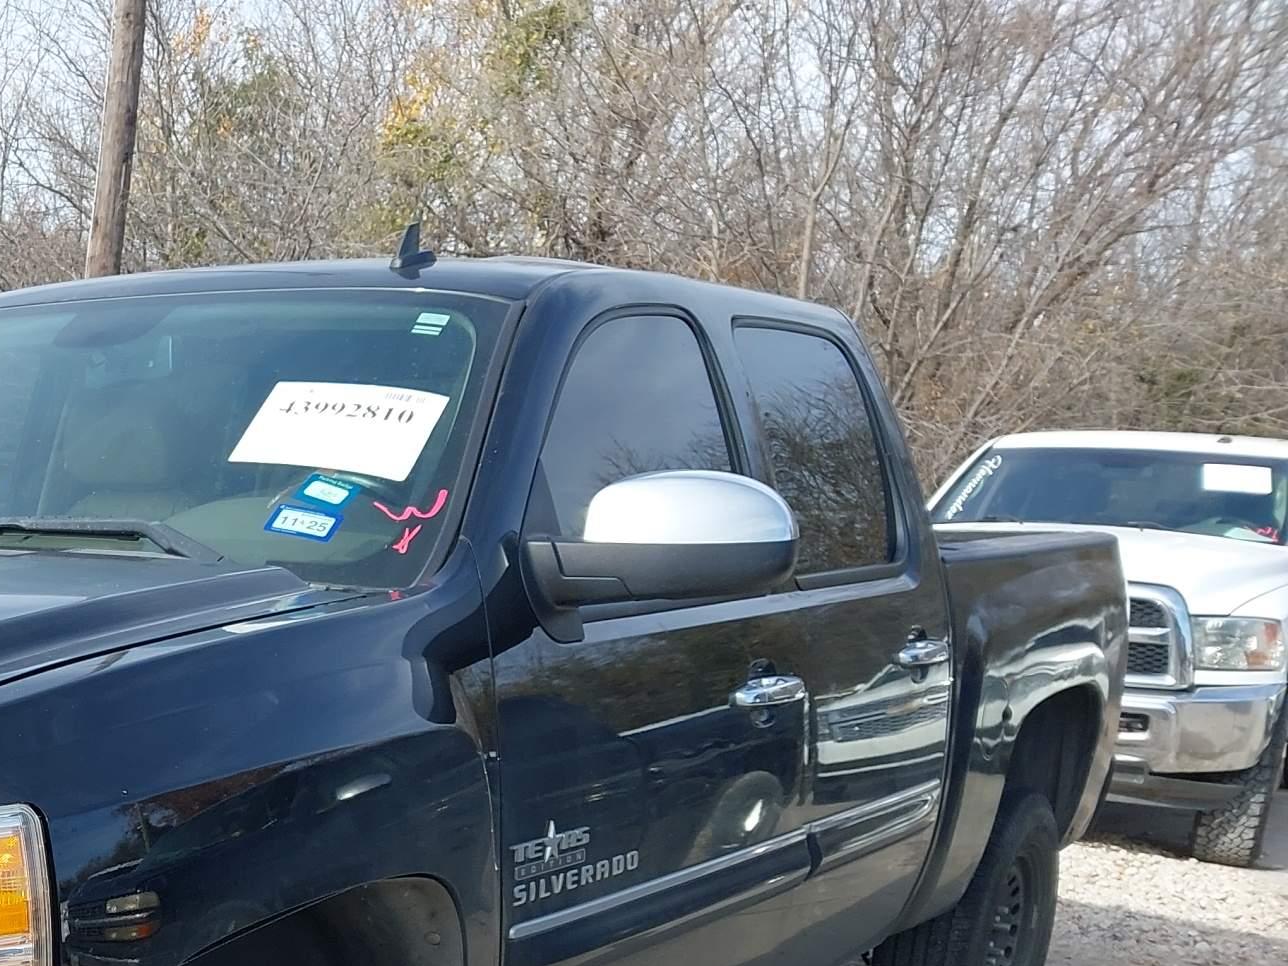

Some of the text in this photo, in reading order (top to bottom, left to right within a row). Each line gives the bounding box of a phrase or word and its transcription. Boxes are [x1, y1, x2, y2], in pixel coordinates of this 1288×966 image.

[280, 400, 414, 424] 43992810
[510, 820, 590, 863] TEXAS
[513, 850, 639, 907] SILVERADO
